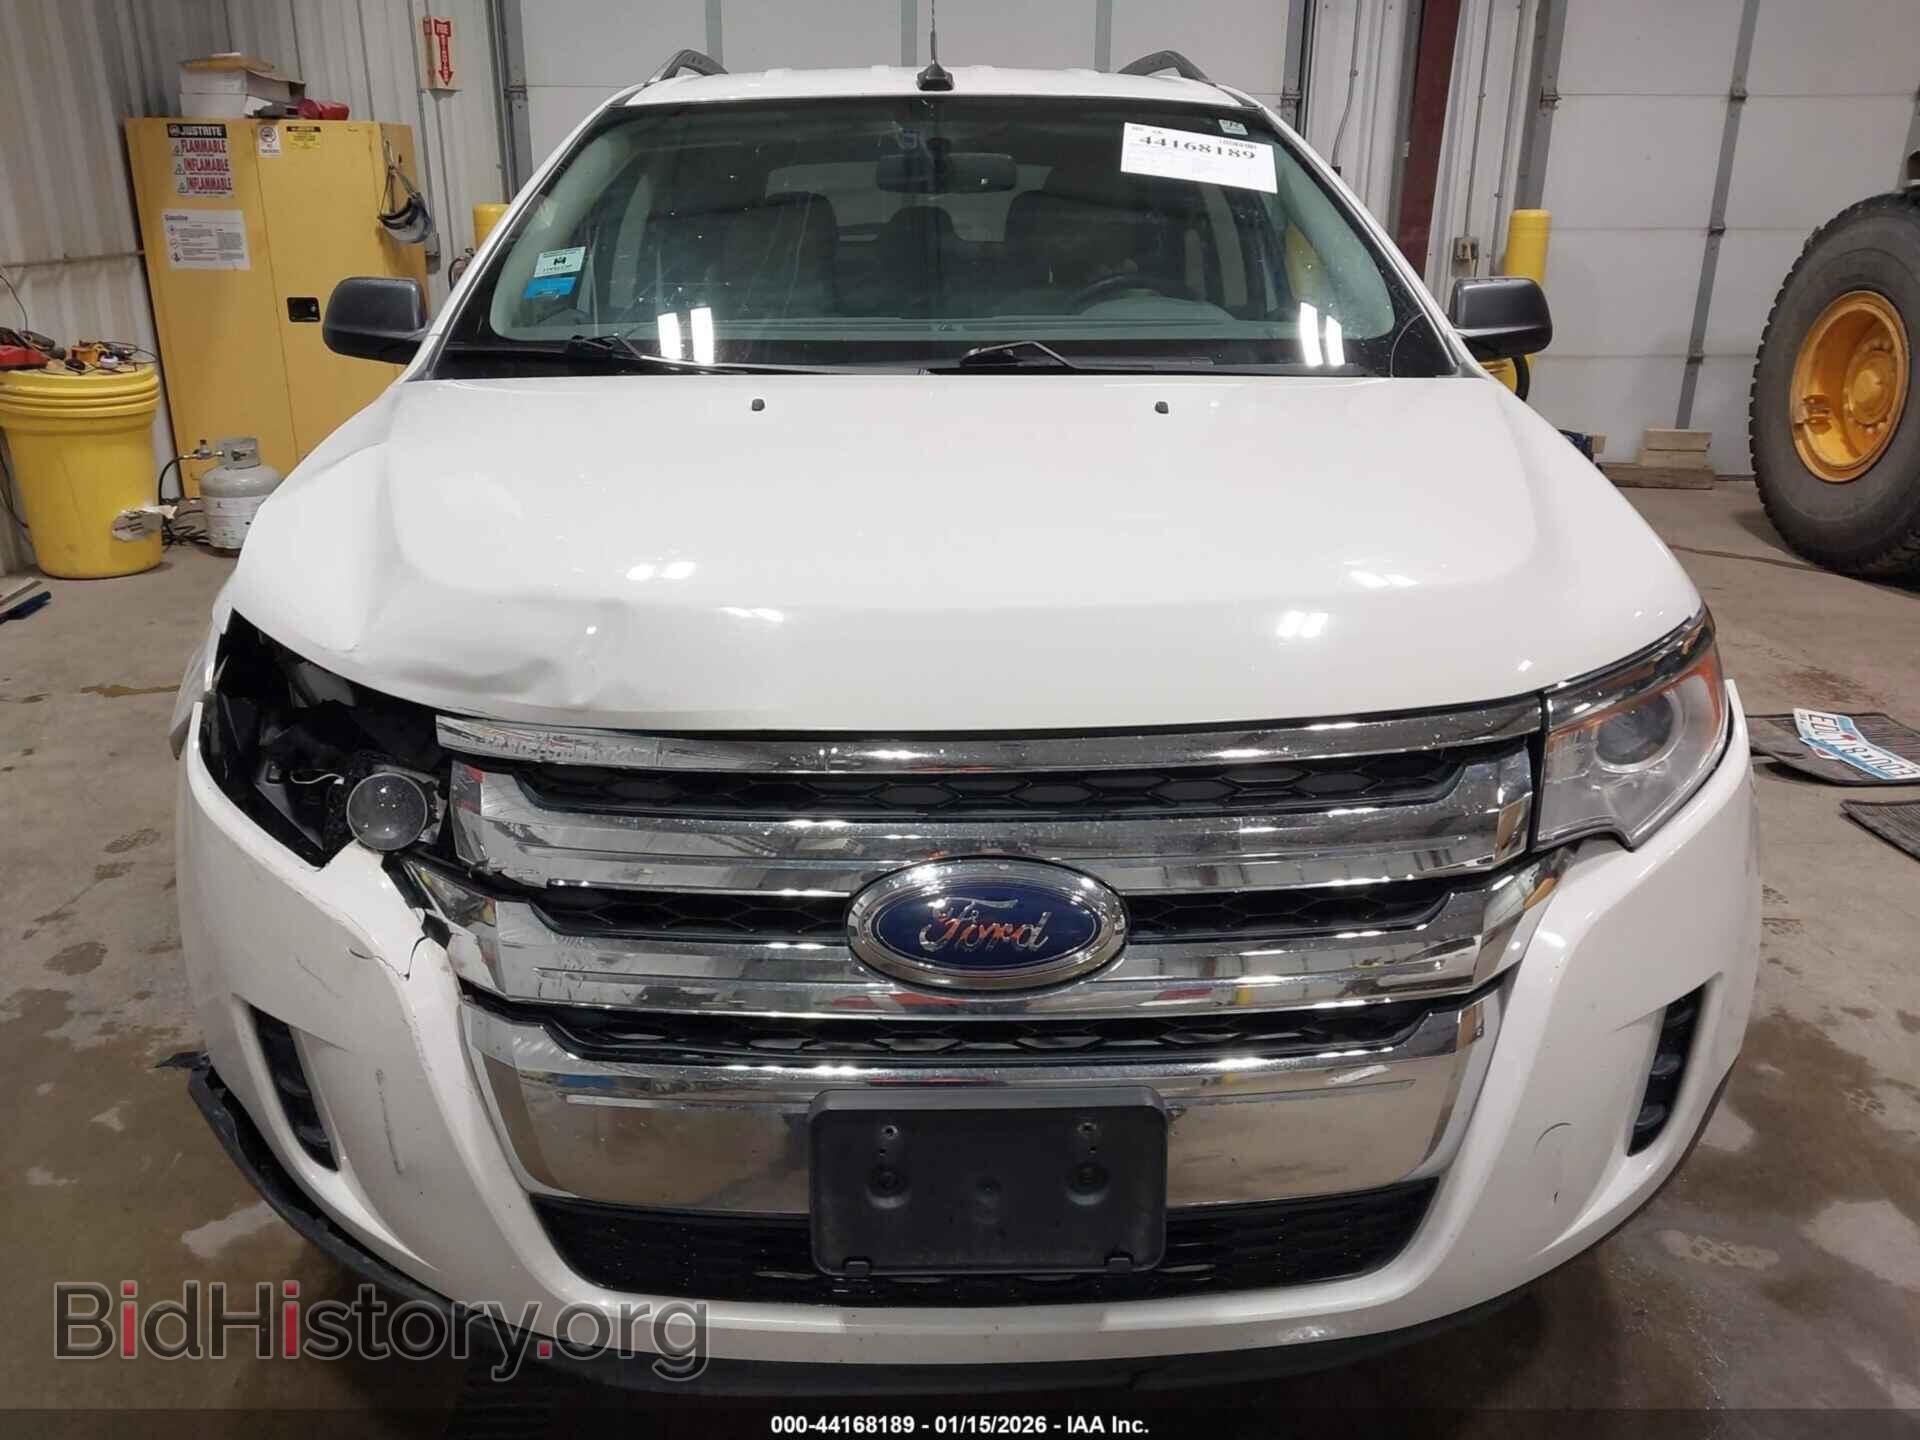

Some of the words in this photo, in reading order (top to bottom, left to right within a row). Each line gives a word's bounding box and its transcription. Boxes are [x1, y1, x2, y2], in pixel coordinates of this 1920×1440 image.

[180, 139, 226, 153] FLAMMABLE
[1139, 136, 1256, 160] 44168189
[919, 896, 1052, 951] Ford
